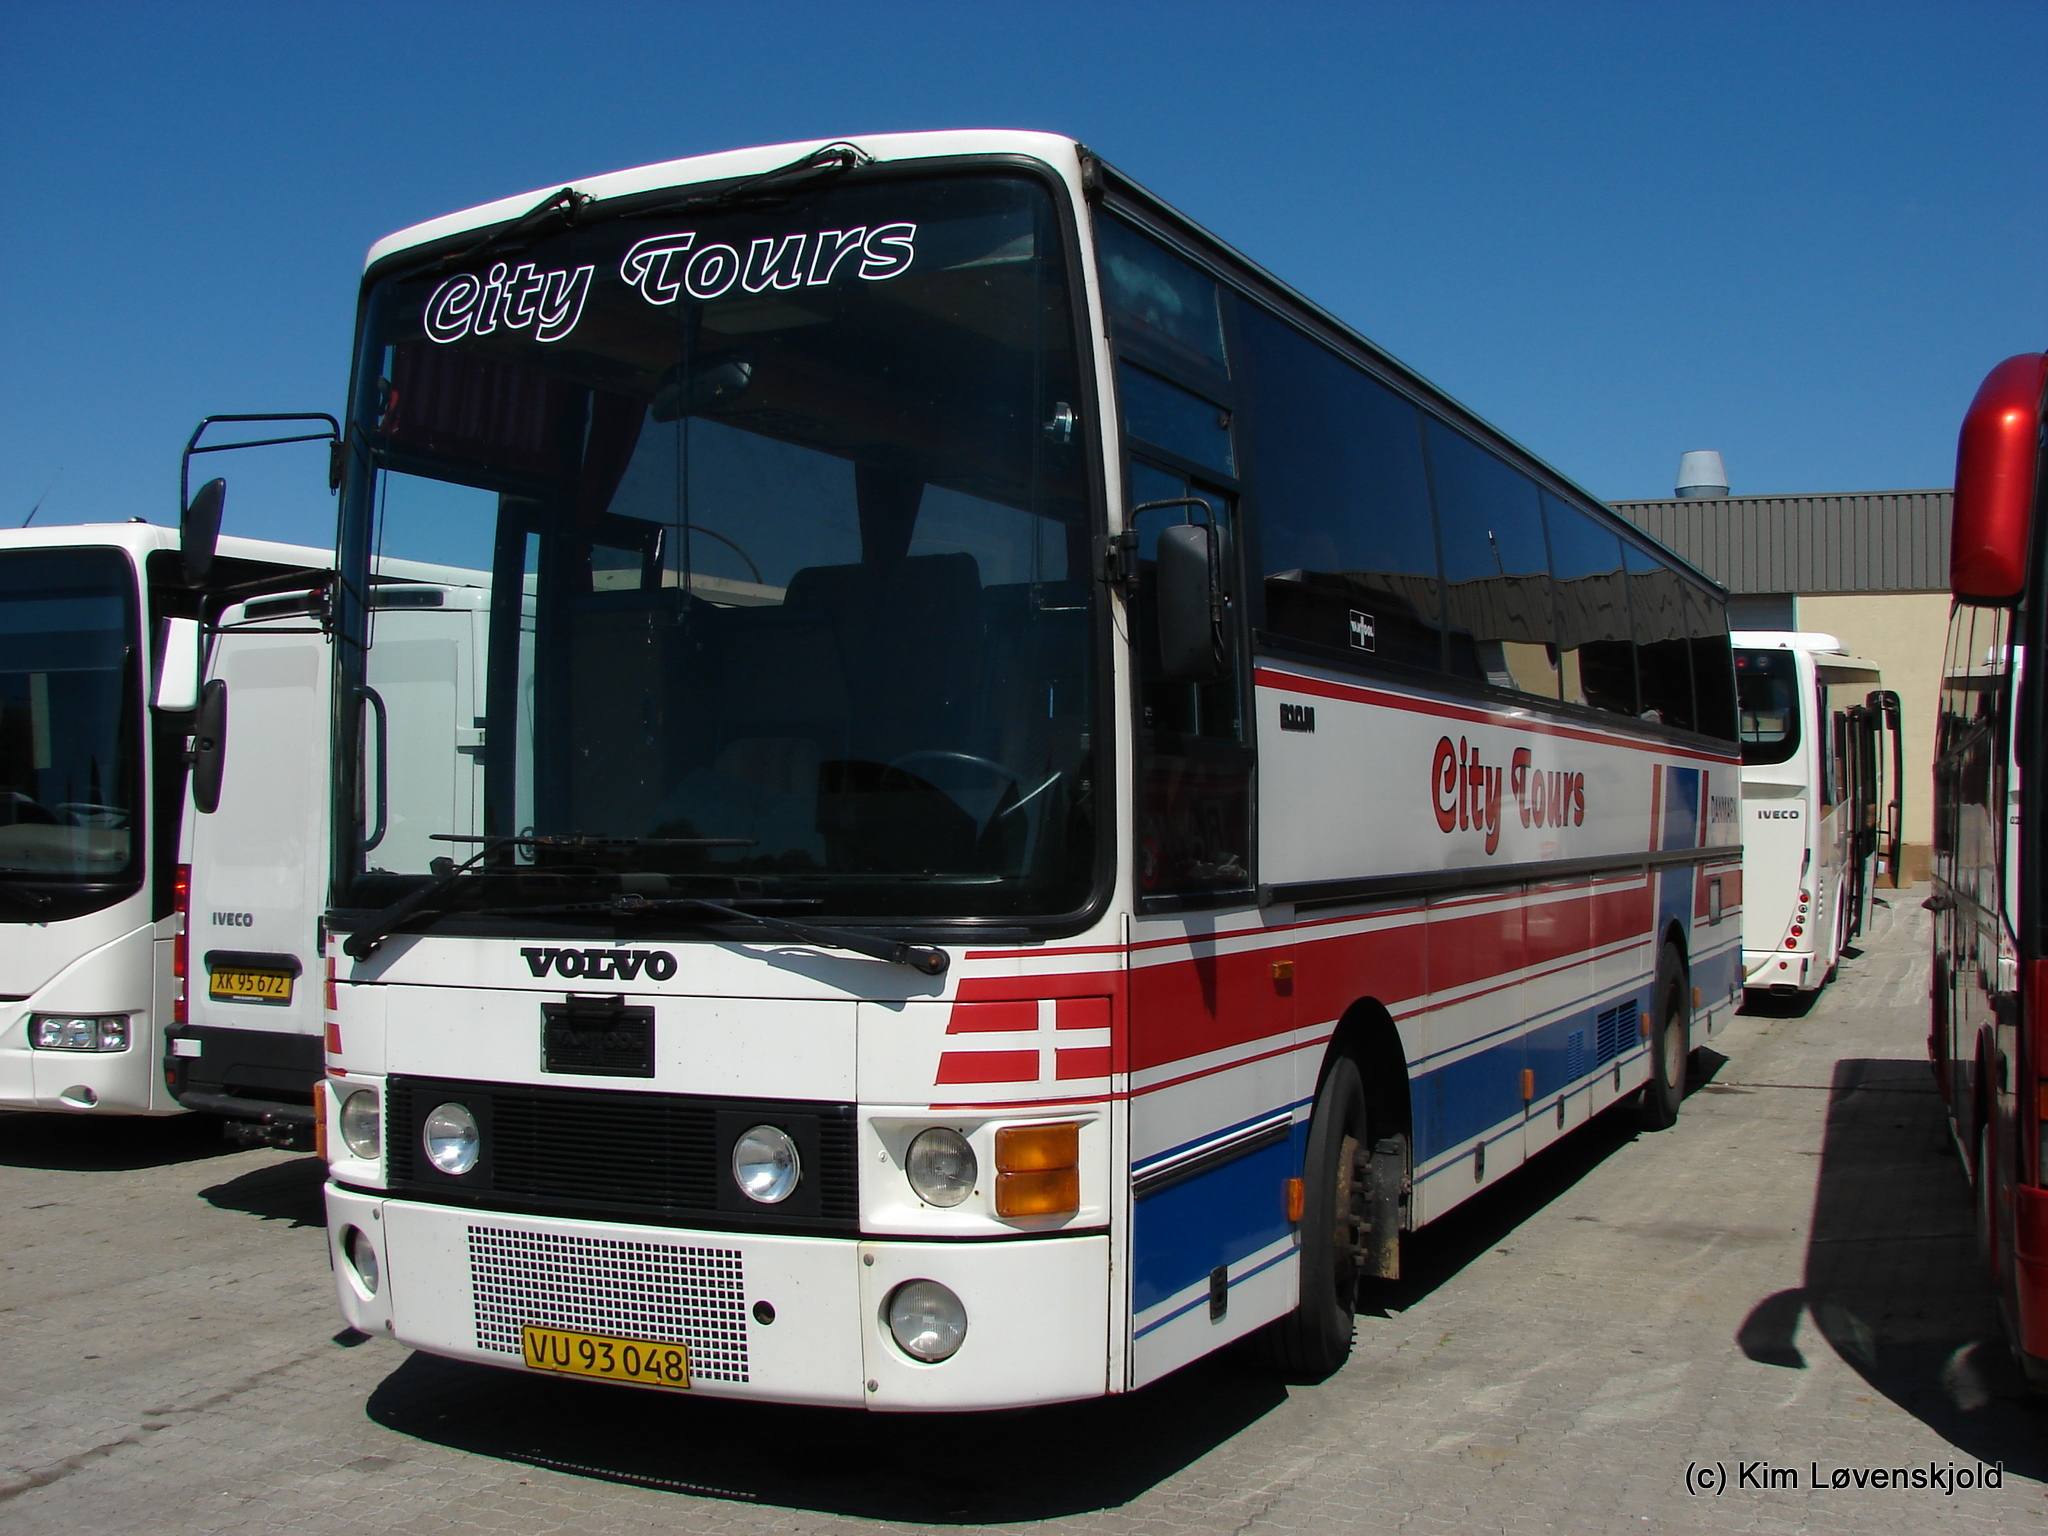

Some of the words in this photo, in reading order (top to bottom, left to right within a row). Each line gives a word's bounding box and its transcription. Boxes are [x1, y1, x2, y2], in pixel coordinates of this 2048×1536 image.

[424, 262, 595, 343] City
[620, 223, 917, 305] Tours
[1431, 736, 1501, 856] City
[1512, 747, 1585, 829] Tours
[1757, 810, 1799, 819] IVECO
[212, 912, 253, 927] IVECO
[521, 947, 677, 980] VOLVO
[216, 972, 234, 990] XK
[238, 973, 254, 991] 95
[257, 975, 284, 994] 672
[530, 1332, 570, 1366] VU
[579, 1339, 615, 1372] 93
[623, 1345, 683, 1381] 048
